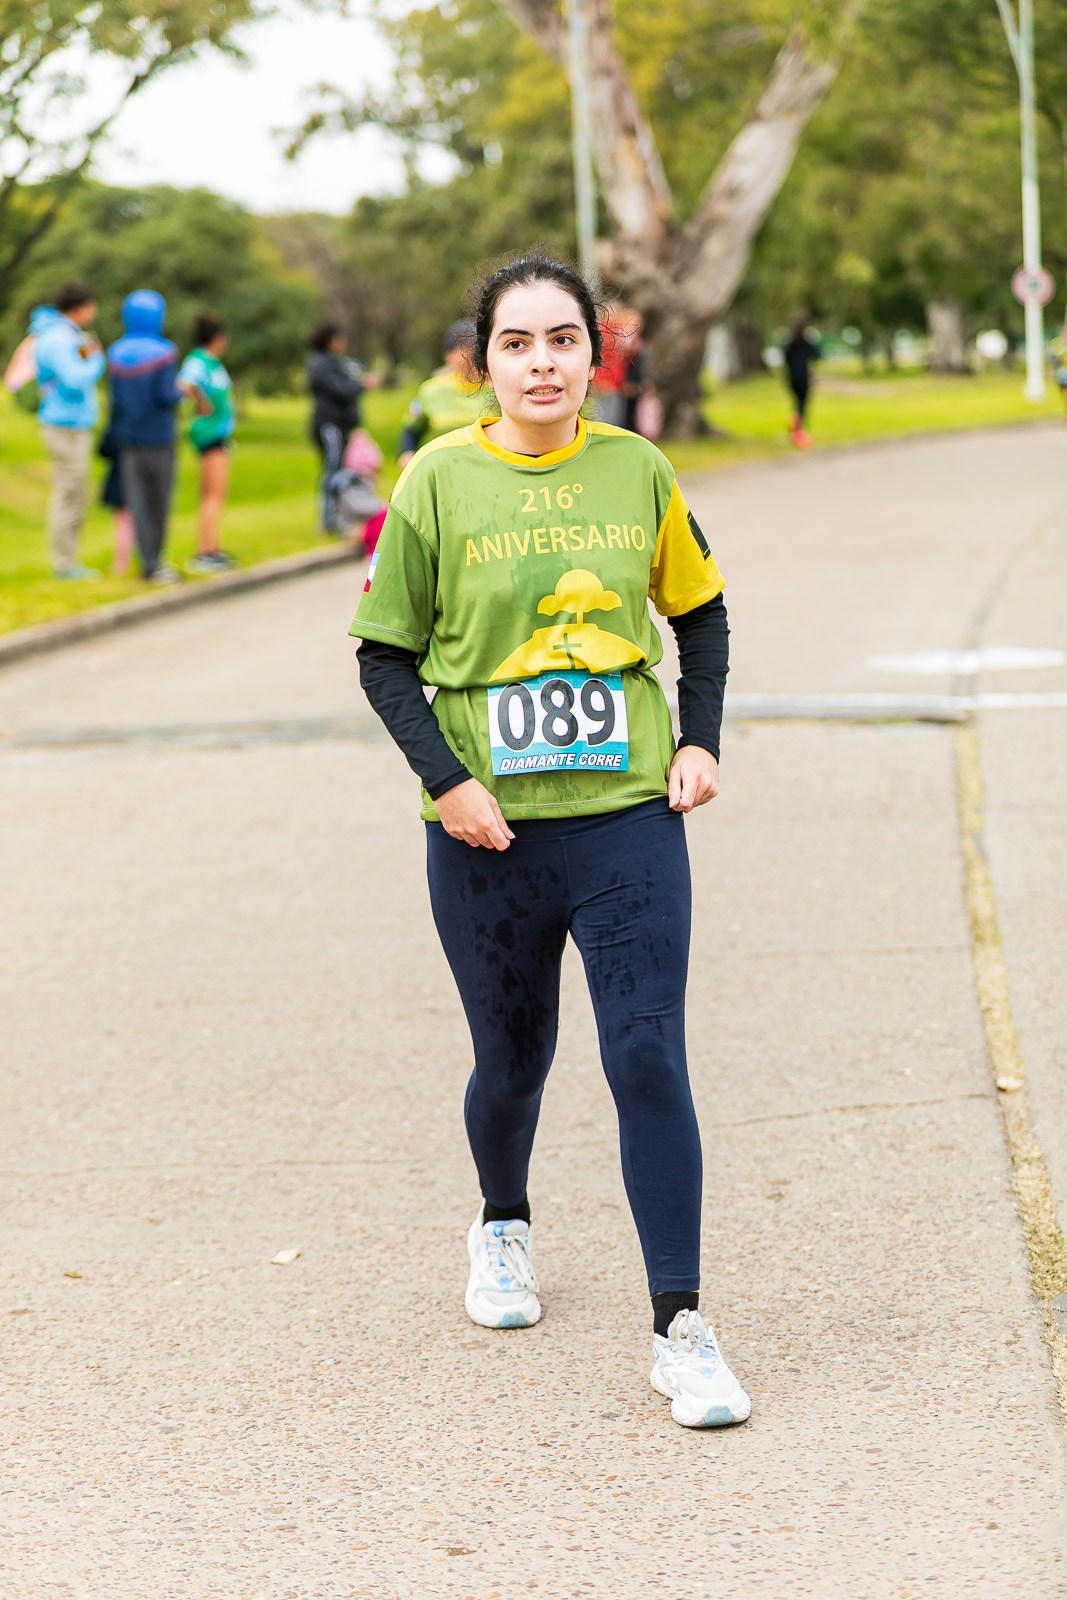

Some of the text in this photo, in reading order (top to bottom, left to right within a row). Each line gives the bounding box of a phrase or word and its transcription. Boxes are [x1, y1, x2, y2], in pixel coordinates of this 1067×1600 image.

[518, 483, 583, 513] 216°
[465, 524, 646, 567] ANIVERSARIO
[497, 678, 615, 751] 089
[500, 753, 623, 771] DIAMANTE CORRE
